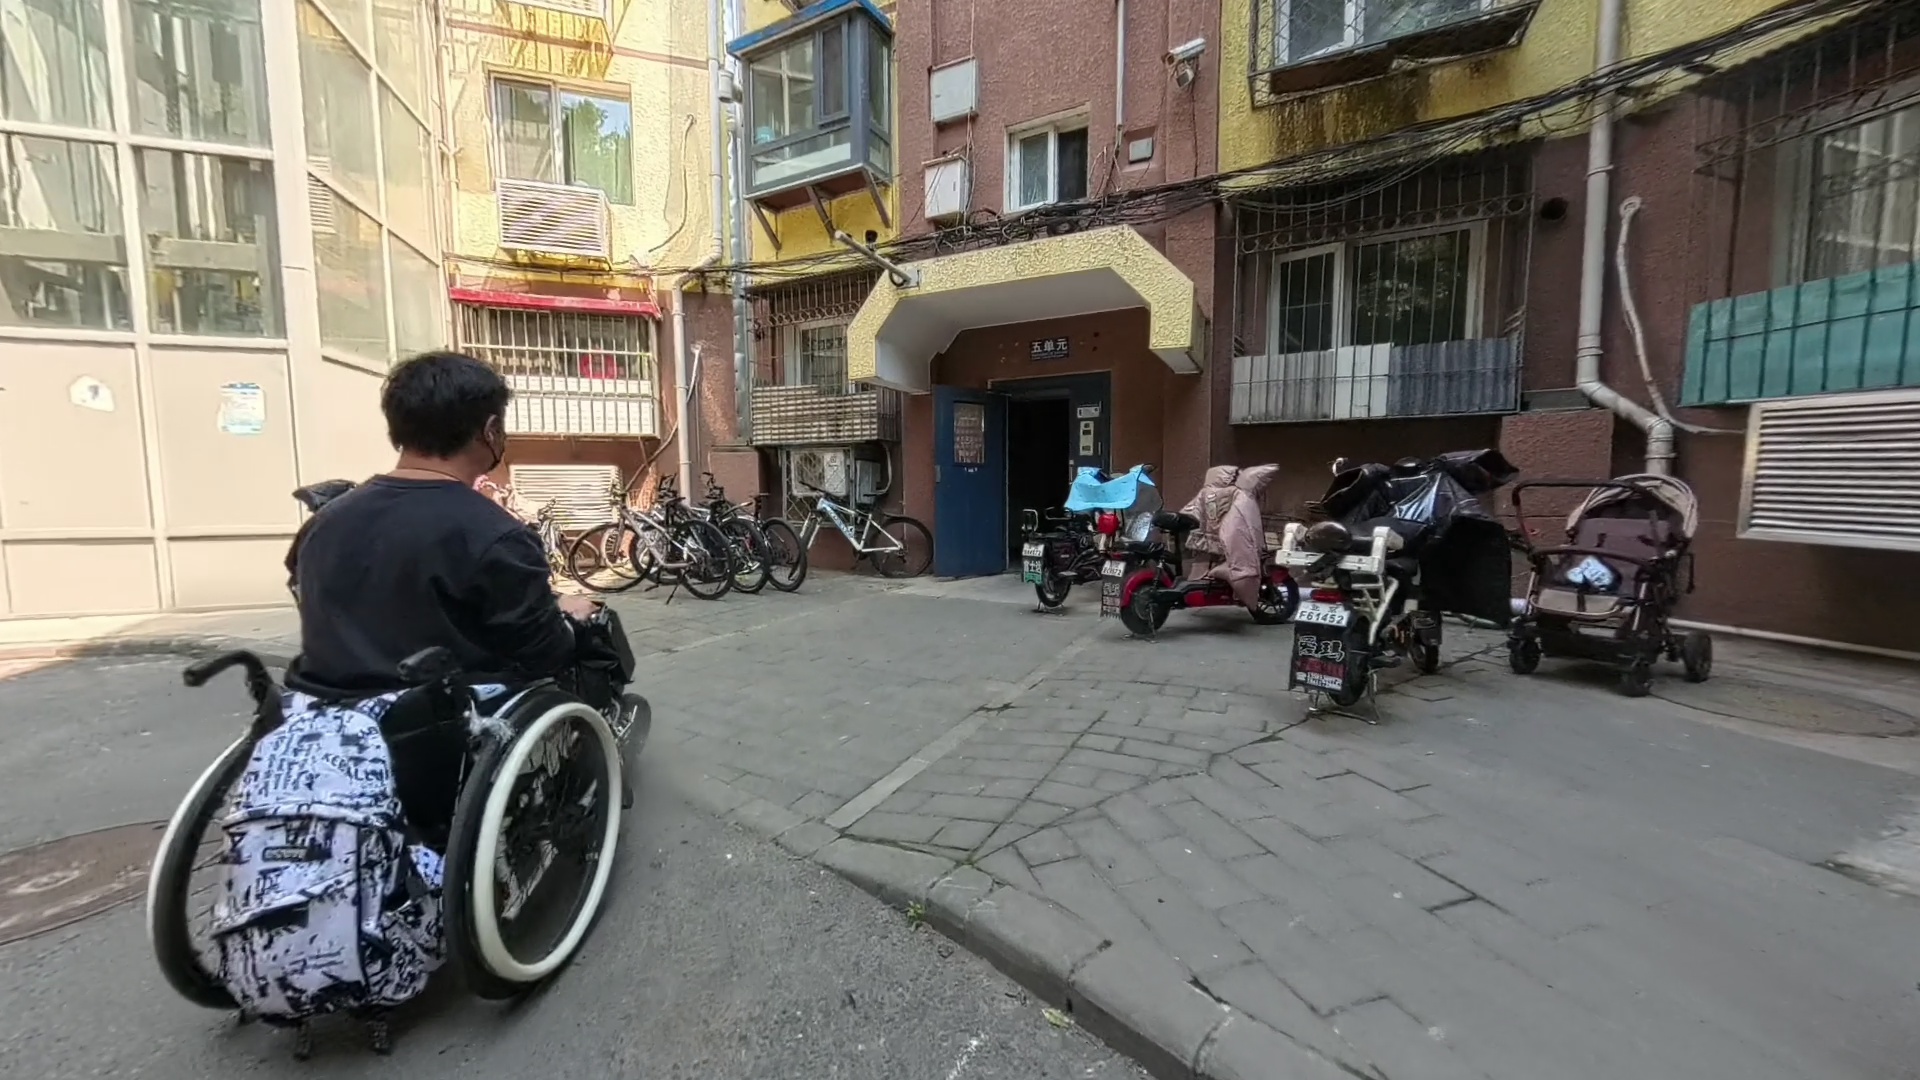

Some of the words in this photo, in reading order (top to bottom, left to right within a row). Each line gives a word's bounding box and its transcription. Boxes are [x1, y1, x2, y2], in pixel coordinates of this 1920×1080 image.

[1031, 338, 1068, 353] 五单元
[1299, 610, 1344, 624] F61452
